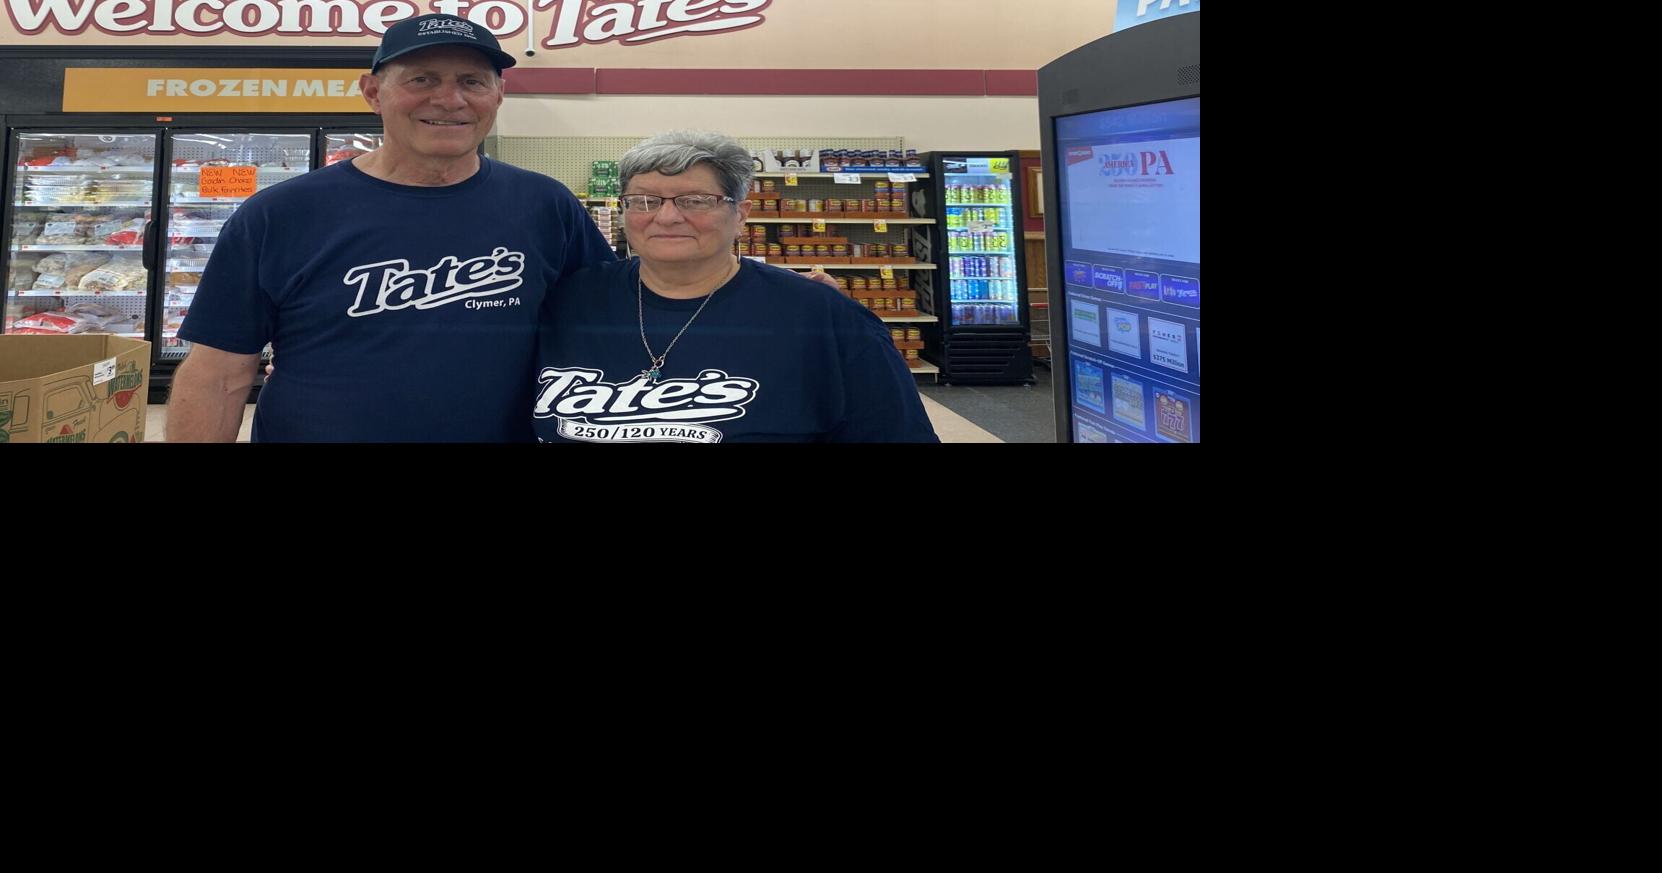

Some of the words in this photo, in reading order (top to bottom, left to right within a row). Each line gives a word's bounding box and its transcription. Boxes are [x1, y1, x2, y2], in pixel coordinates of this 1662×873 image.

[533, 0, 765, 48] Tates
[146, 79, 288, 97] FROZEN
[1140, 150, 1175, 176] PA
[343, 246, 525, 317] Tate's
[464, 299, 507, 310] Clymer,
[508, 297, 521, 306] PA
[533, 367, 759, 424] Tate's
[573, 425, 656, 440] 250/120
[659, 427, 708, 440] YEARS
